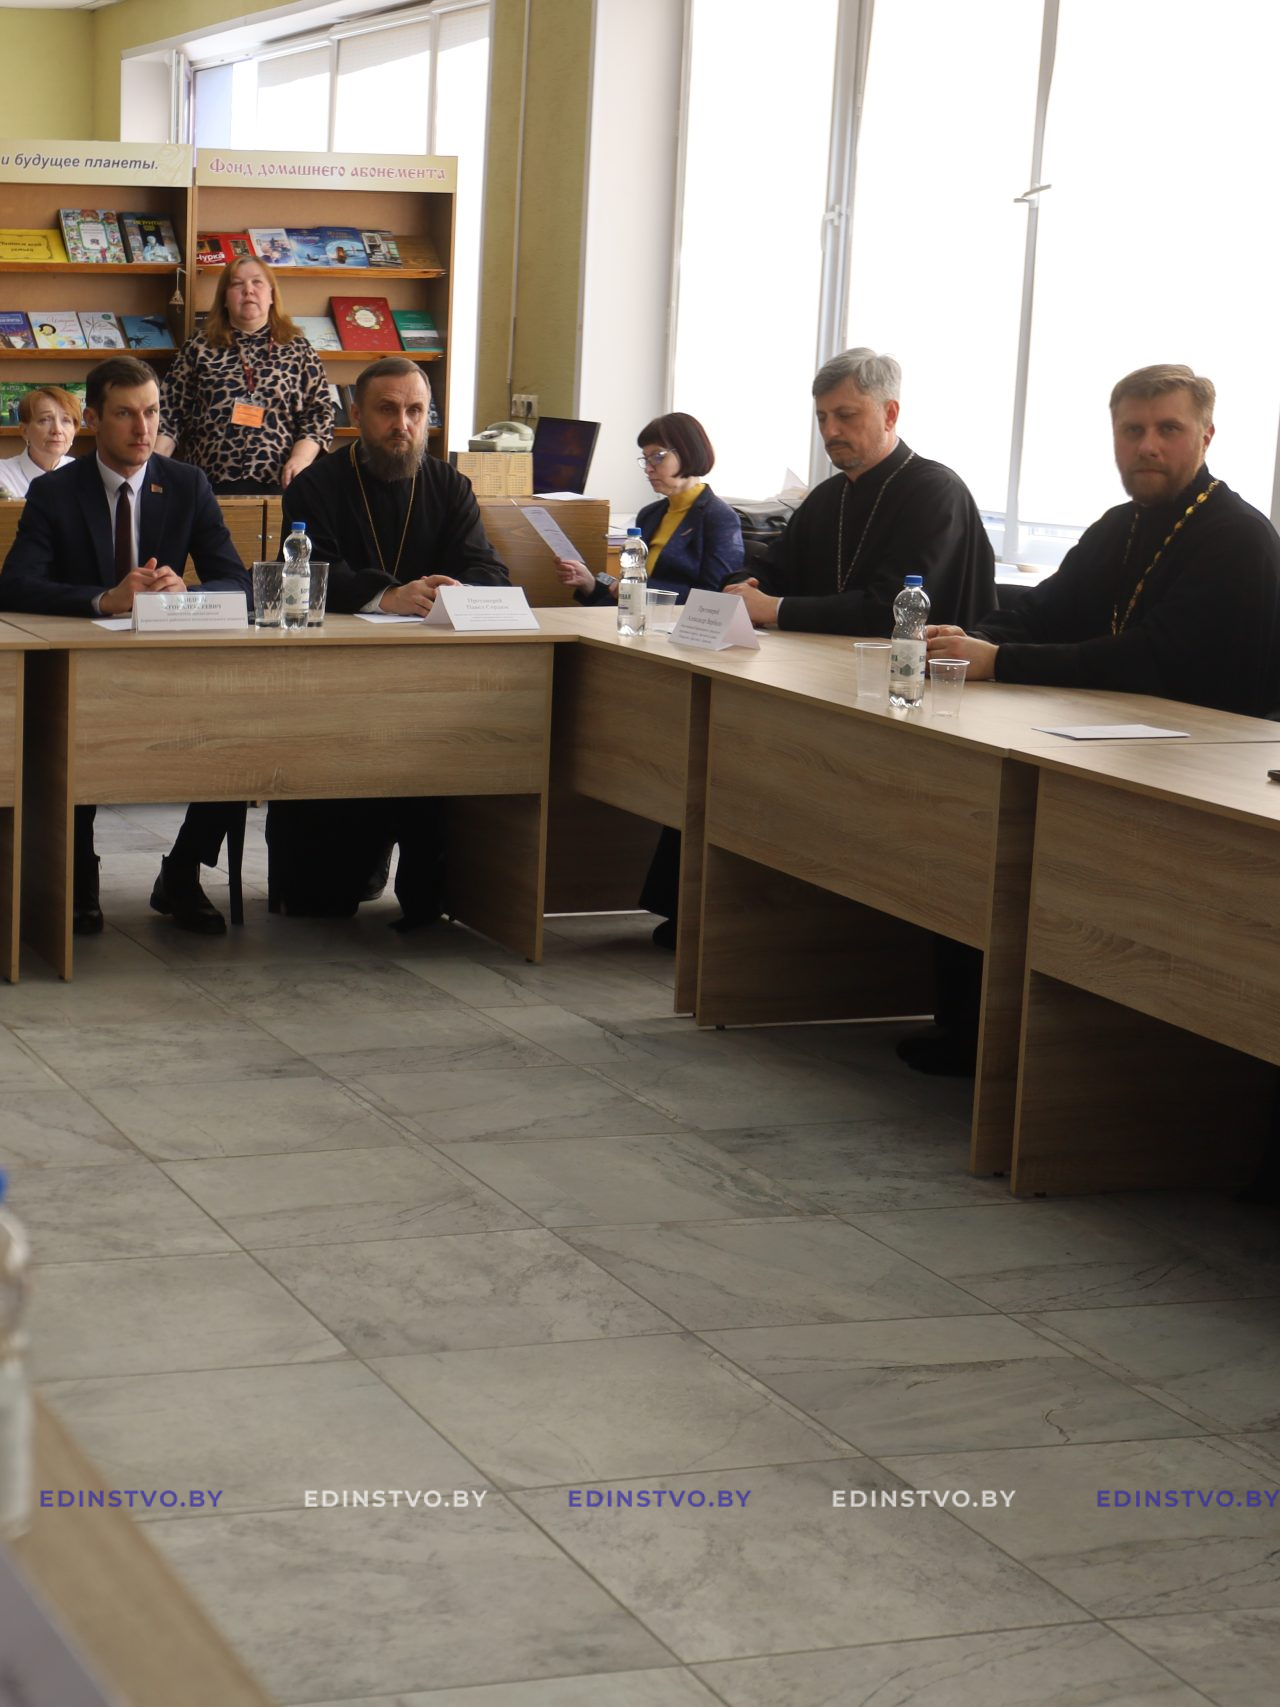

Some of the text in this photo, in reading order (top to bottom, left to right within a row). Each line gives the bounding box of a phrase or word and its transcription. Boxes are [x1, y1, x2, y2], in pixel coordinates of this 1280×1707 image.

[1, 156, 10, 165] и
[14, 153, 80, 169] будущее
[84, 156, 159, 170] планеты.
[209, 158, 446, 180] Фонд домашнего абонемента
